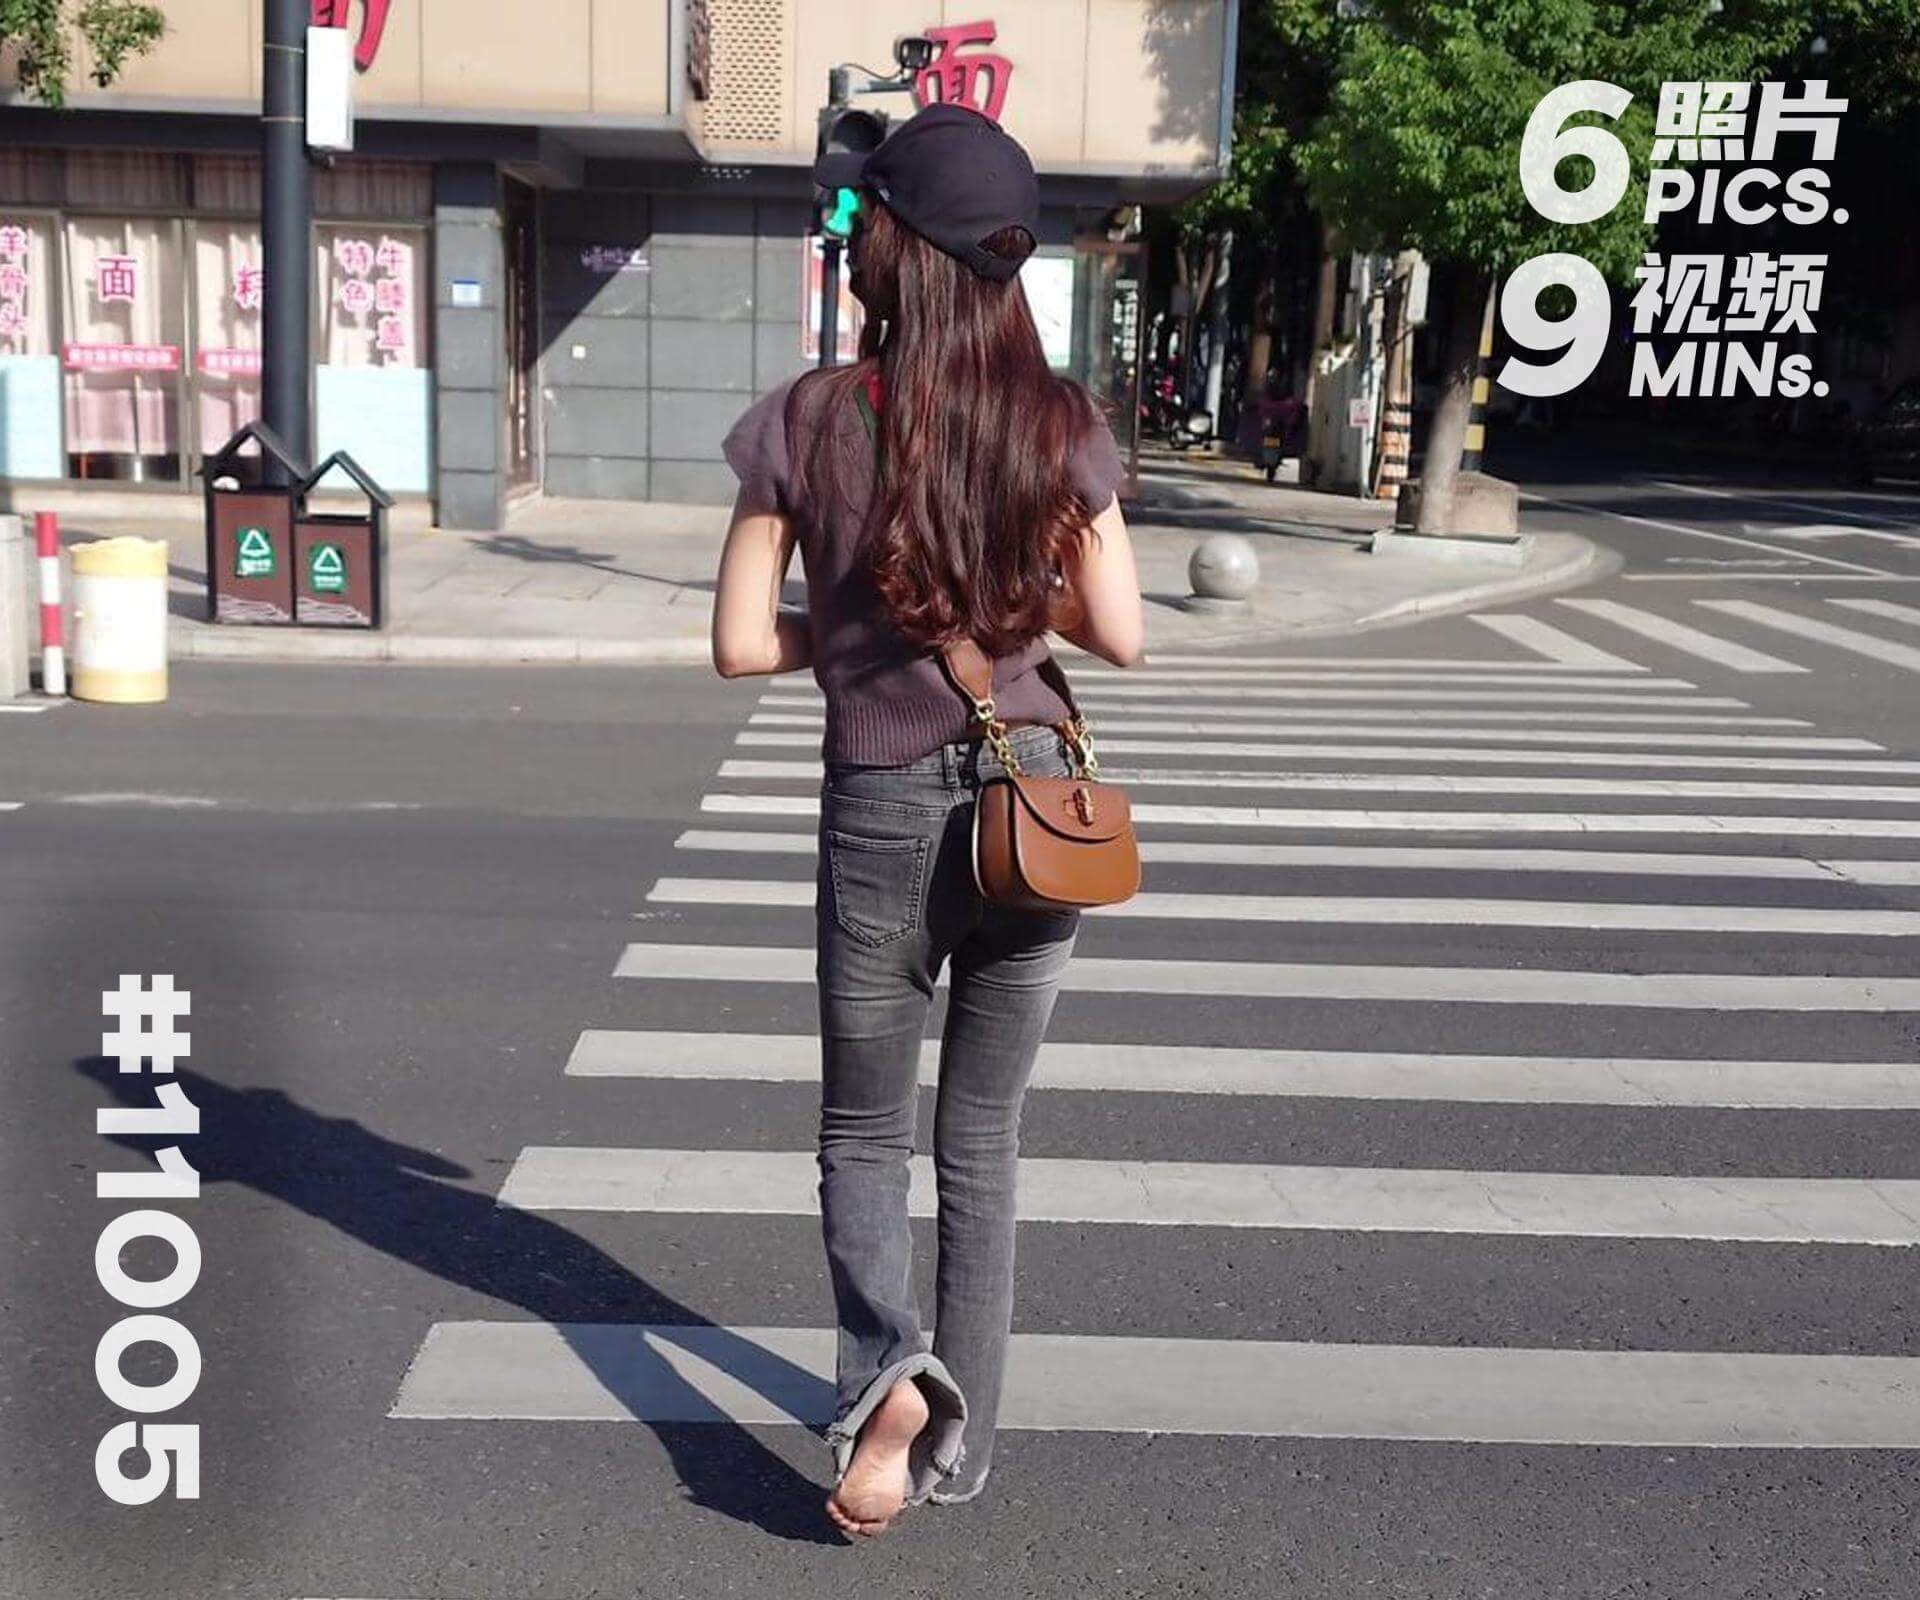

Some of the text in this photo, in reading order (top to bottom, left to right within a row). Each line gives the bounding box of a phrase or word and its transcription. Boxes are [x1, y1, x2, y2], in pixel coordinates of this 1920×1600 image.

[914, 20, 1014, 122] 面
[98, 256, 137, 299] 面
[342, 243, 370, 309] 特色
